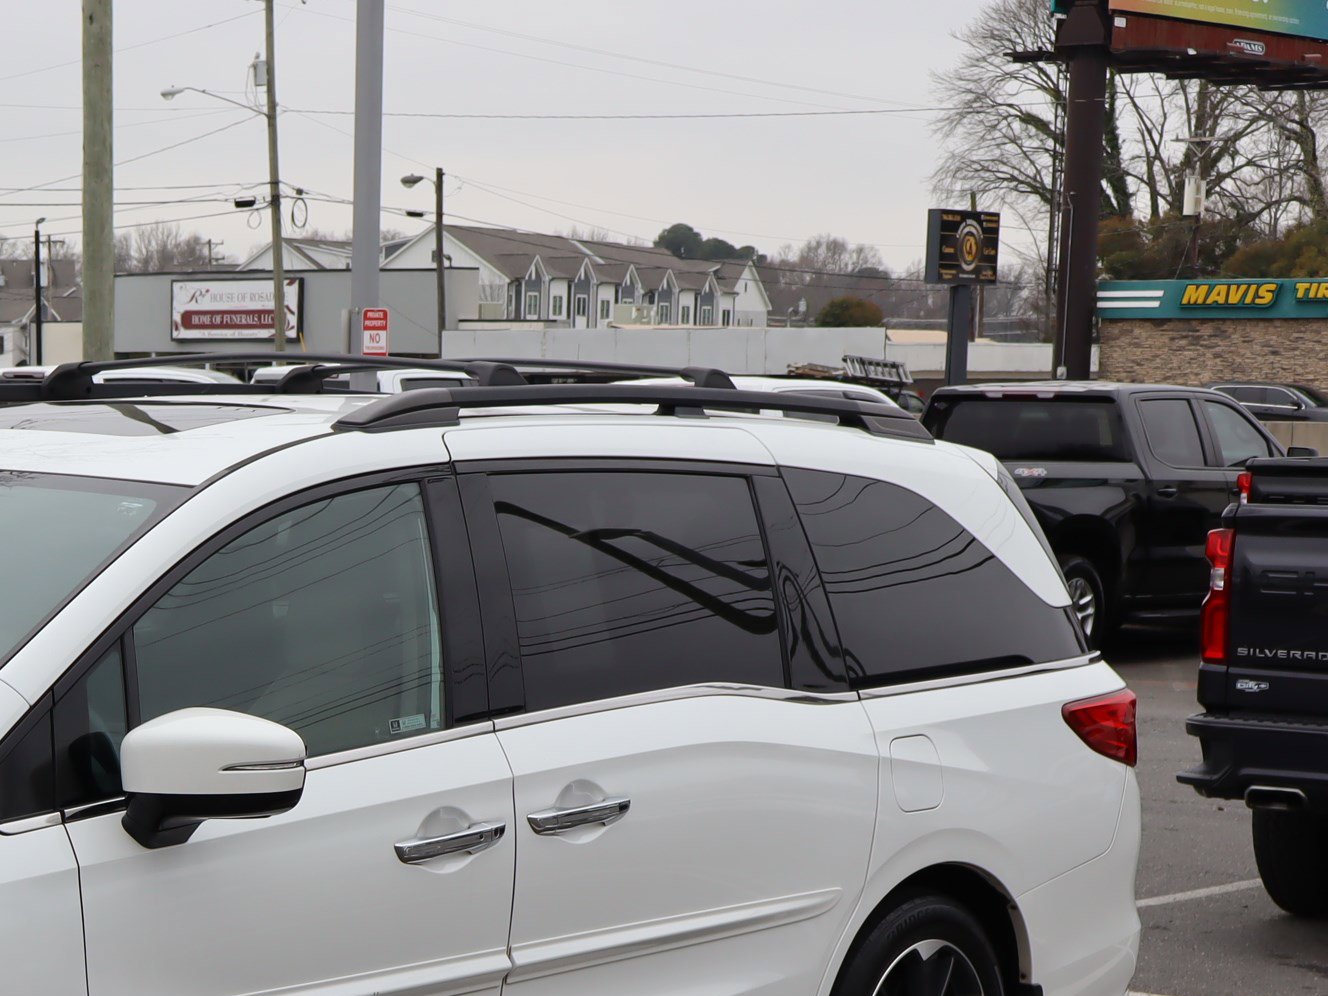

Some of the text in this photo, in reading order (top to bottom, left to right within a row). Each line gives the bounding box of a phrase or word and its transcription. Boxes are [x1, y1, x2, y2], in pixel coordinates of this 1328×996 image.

[210, 292, 236, 304] HOUSE
[237, 292, 247, 303] OF
[1181, 283, 1278, 305] MAVIS
[192, 314, 212, 325] HOME
[212, 314, 222, 324] OF
[366, 311, 384, 319] PRIVATE
[369, 333, 381, 344] NO
